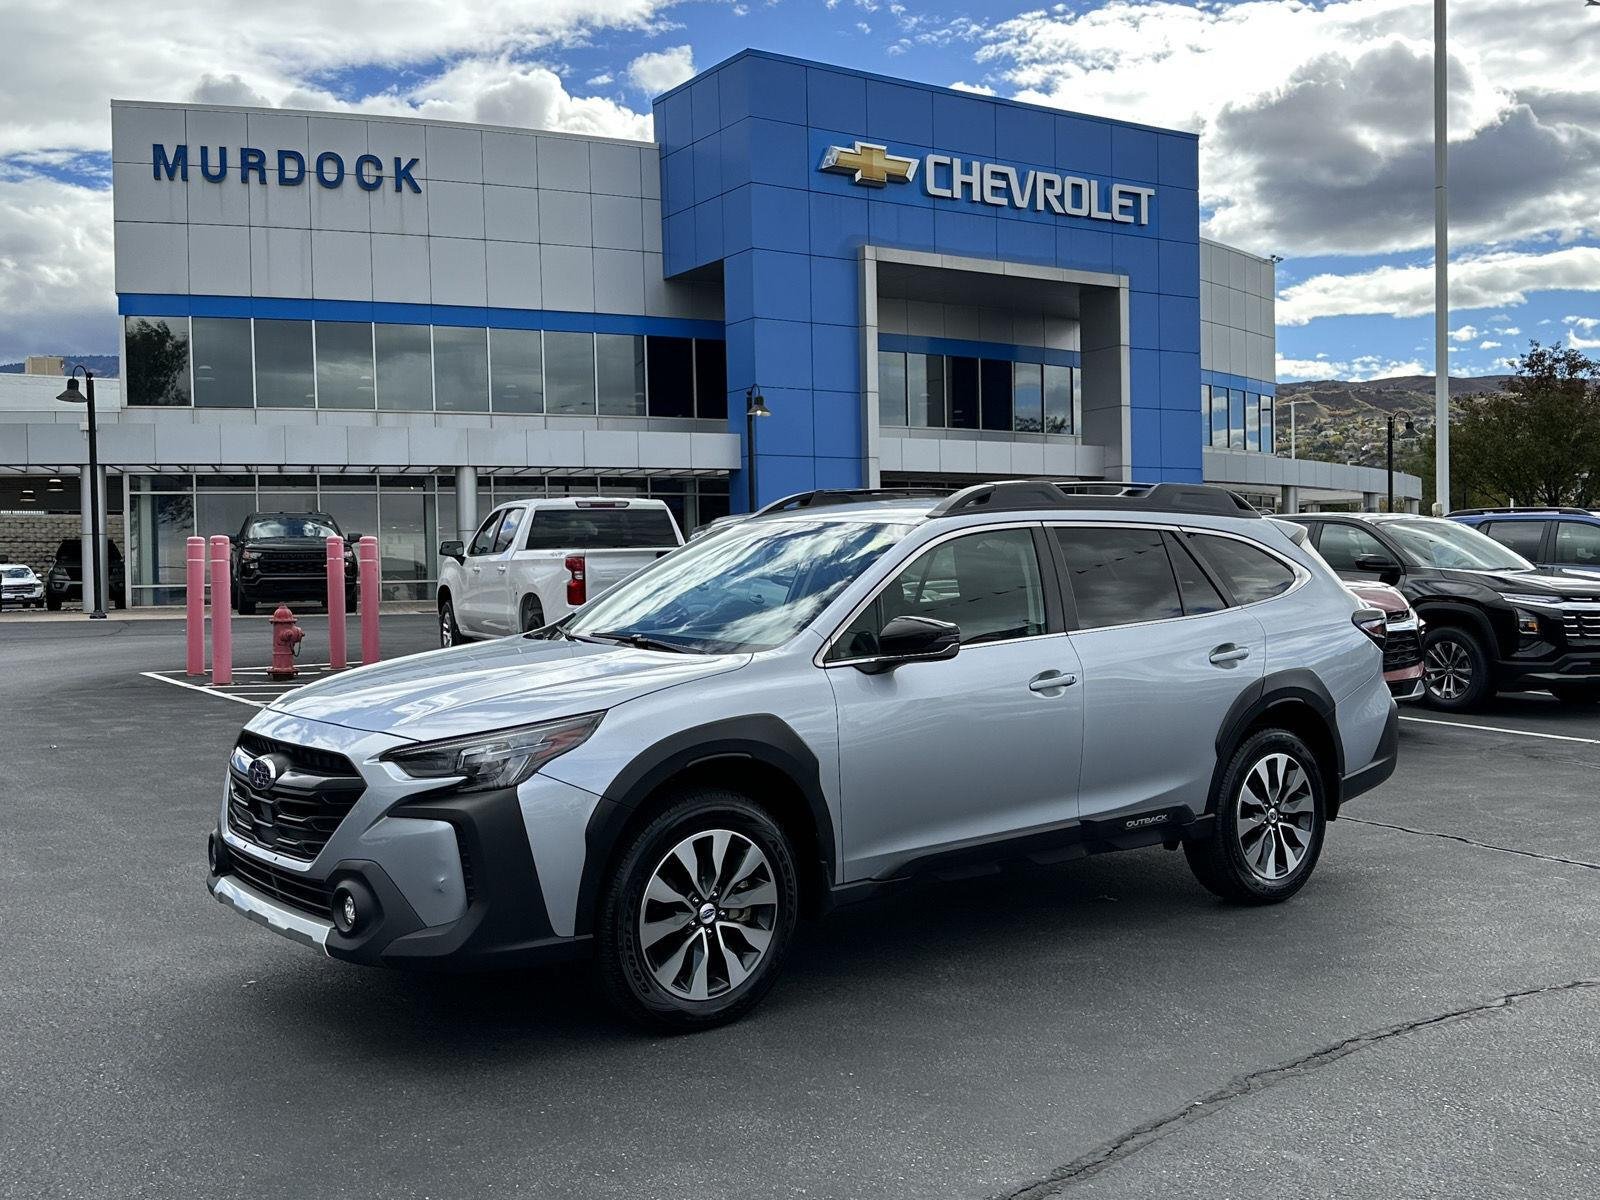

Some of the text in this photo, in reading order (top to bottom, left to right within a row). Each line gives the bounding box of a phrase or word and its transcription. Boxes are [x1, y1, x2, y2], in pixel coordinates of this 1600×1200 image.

[152, 143, 422, 194] MURDOCK
[925, 153, 1156, 226] CHEVROLET
[1126, 814, 1168, 828] OUTBACK
